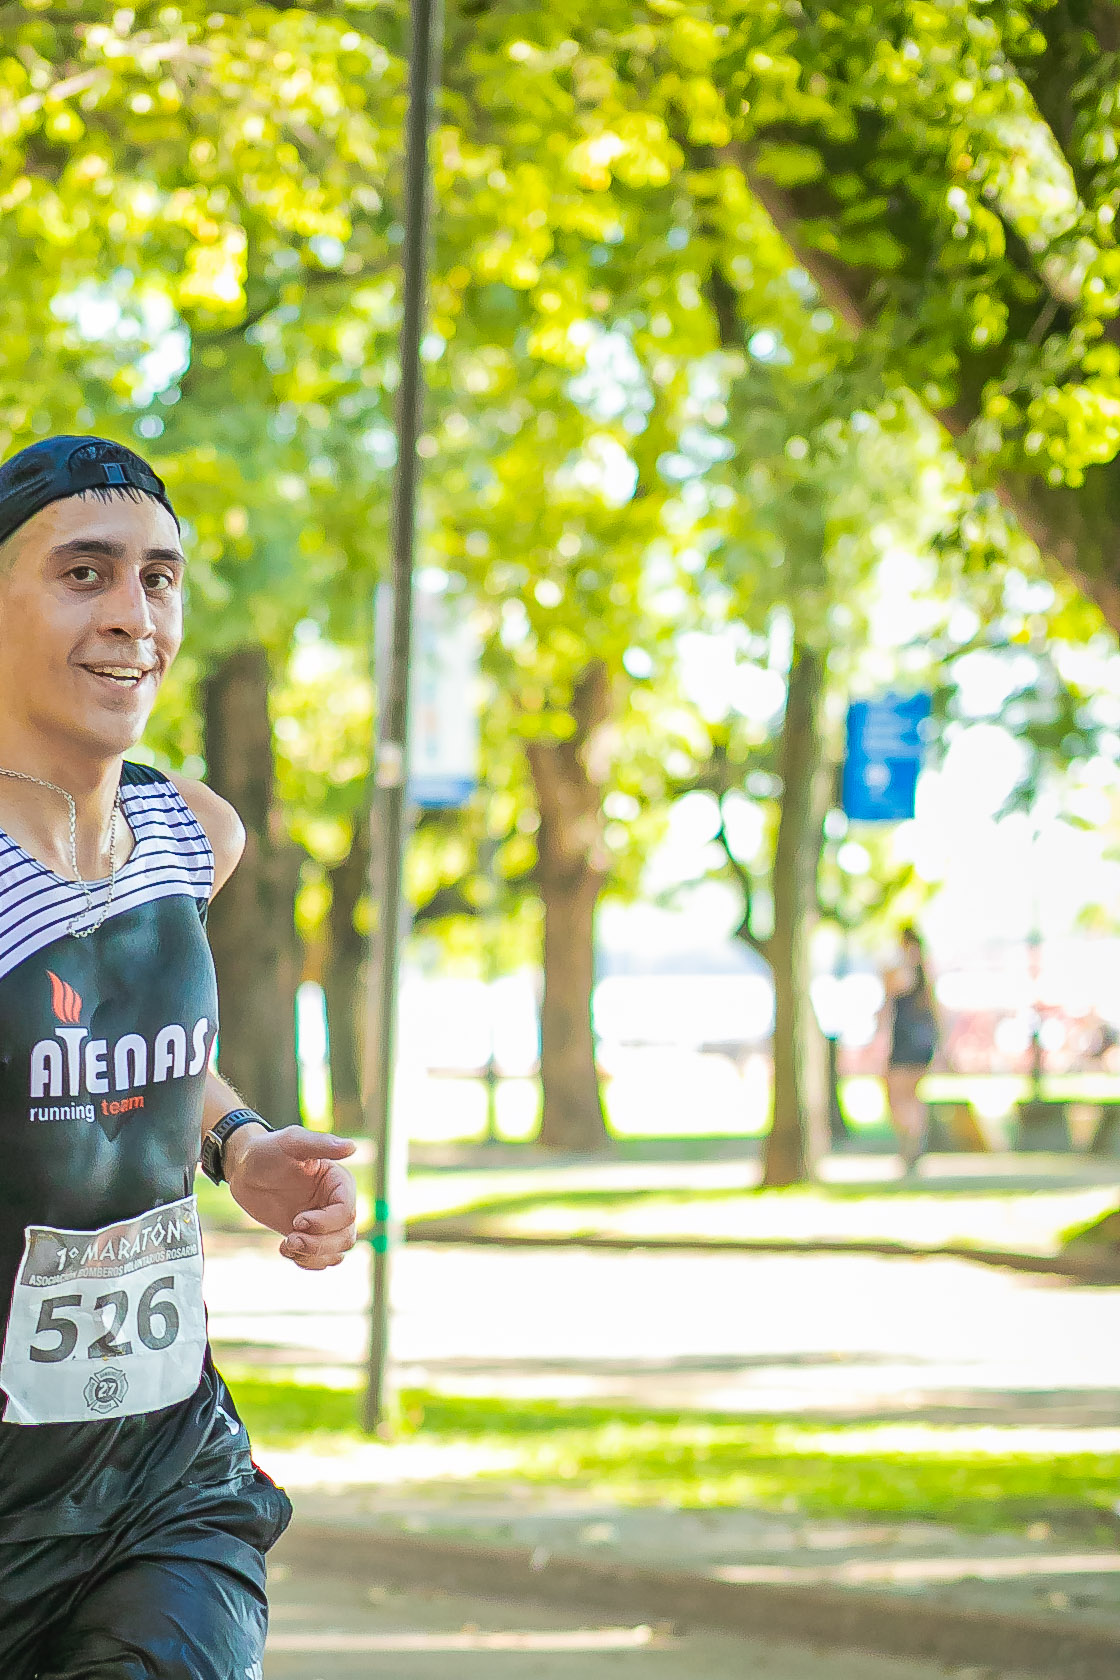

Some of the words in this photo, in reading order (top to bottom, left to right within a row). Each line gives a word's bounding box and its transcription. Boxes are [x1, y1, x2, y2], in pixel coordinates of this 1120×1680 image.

[30, 1017, 209, 1098] ATENAS
[30, 1102, 95, 1123] running
[101, 1096, 145, 1116] team
[80, 1215, 181, 1265] MARATÓN
[165, 1244, 198, 1261] ROSARIO
[30, 1275, 180, 1363] 526
[97, 1381, 117, 1399] 27
